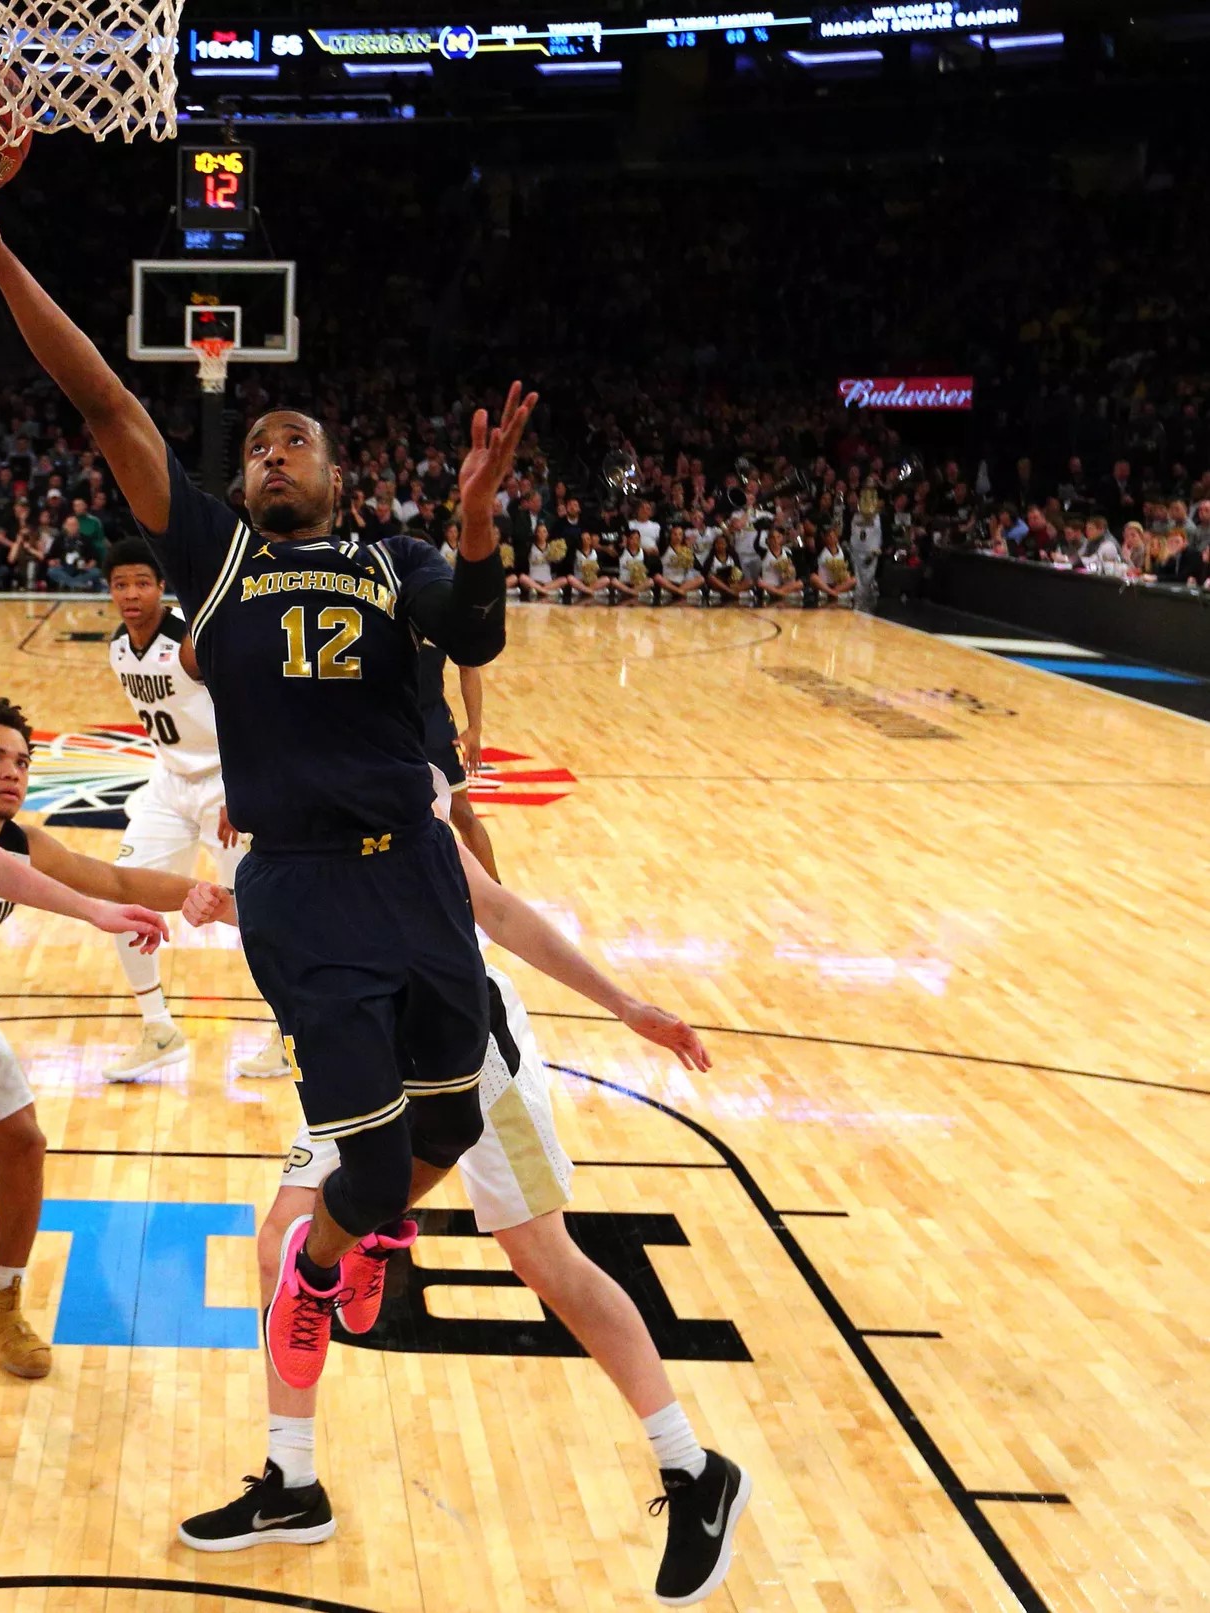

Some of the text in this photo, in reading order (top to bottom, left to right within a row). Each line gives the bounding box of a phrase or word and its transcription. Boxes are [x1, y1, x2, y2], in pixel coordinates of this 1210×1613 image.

[821, 8, 1018, 37] MADISON SQUARE GARDEN
[935, 2, 953, 14] TO
[329, 34, 431, 54] MICHIGAN
[206, 174, 237, 208] 12
[840, 380, 972, 408] Budweiser
[241, 570, 397, 620] MICHIGAN
[281, 606, 362, 679] 12
[121, 672, 175, 704] PURDUE
[139, 710, 181, 745] 20
